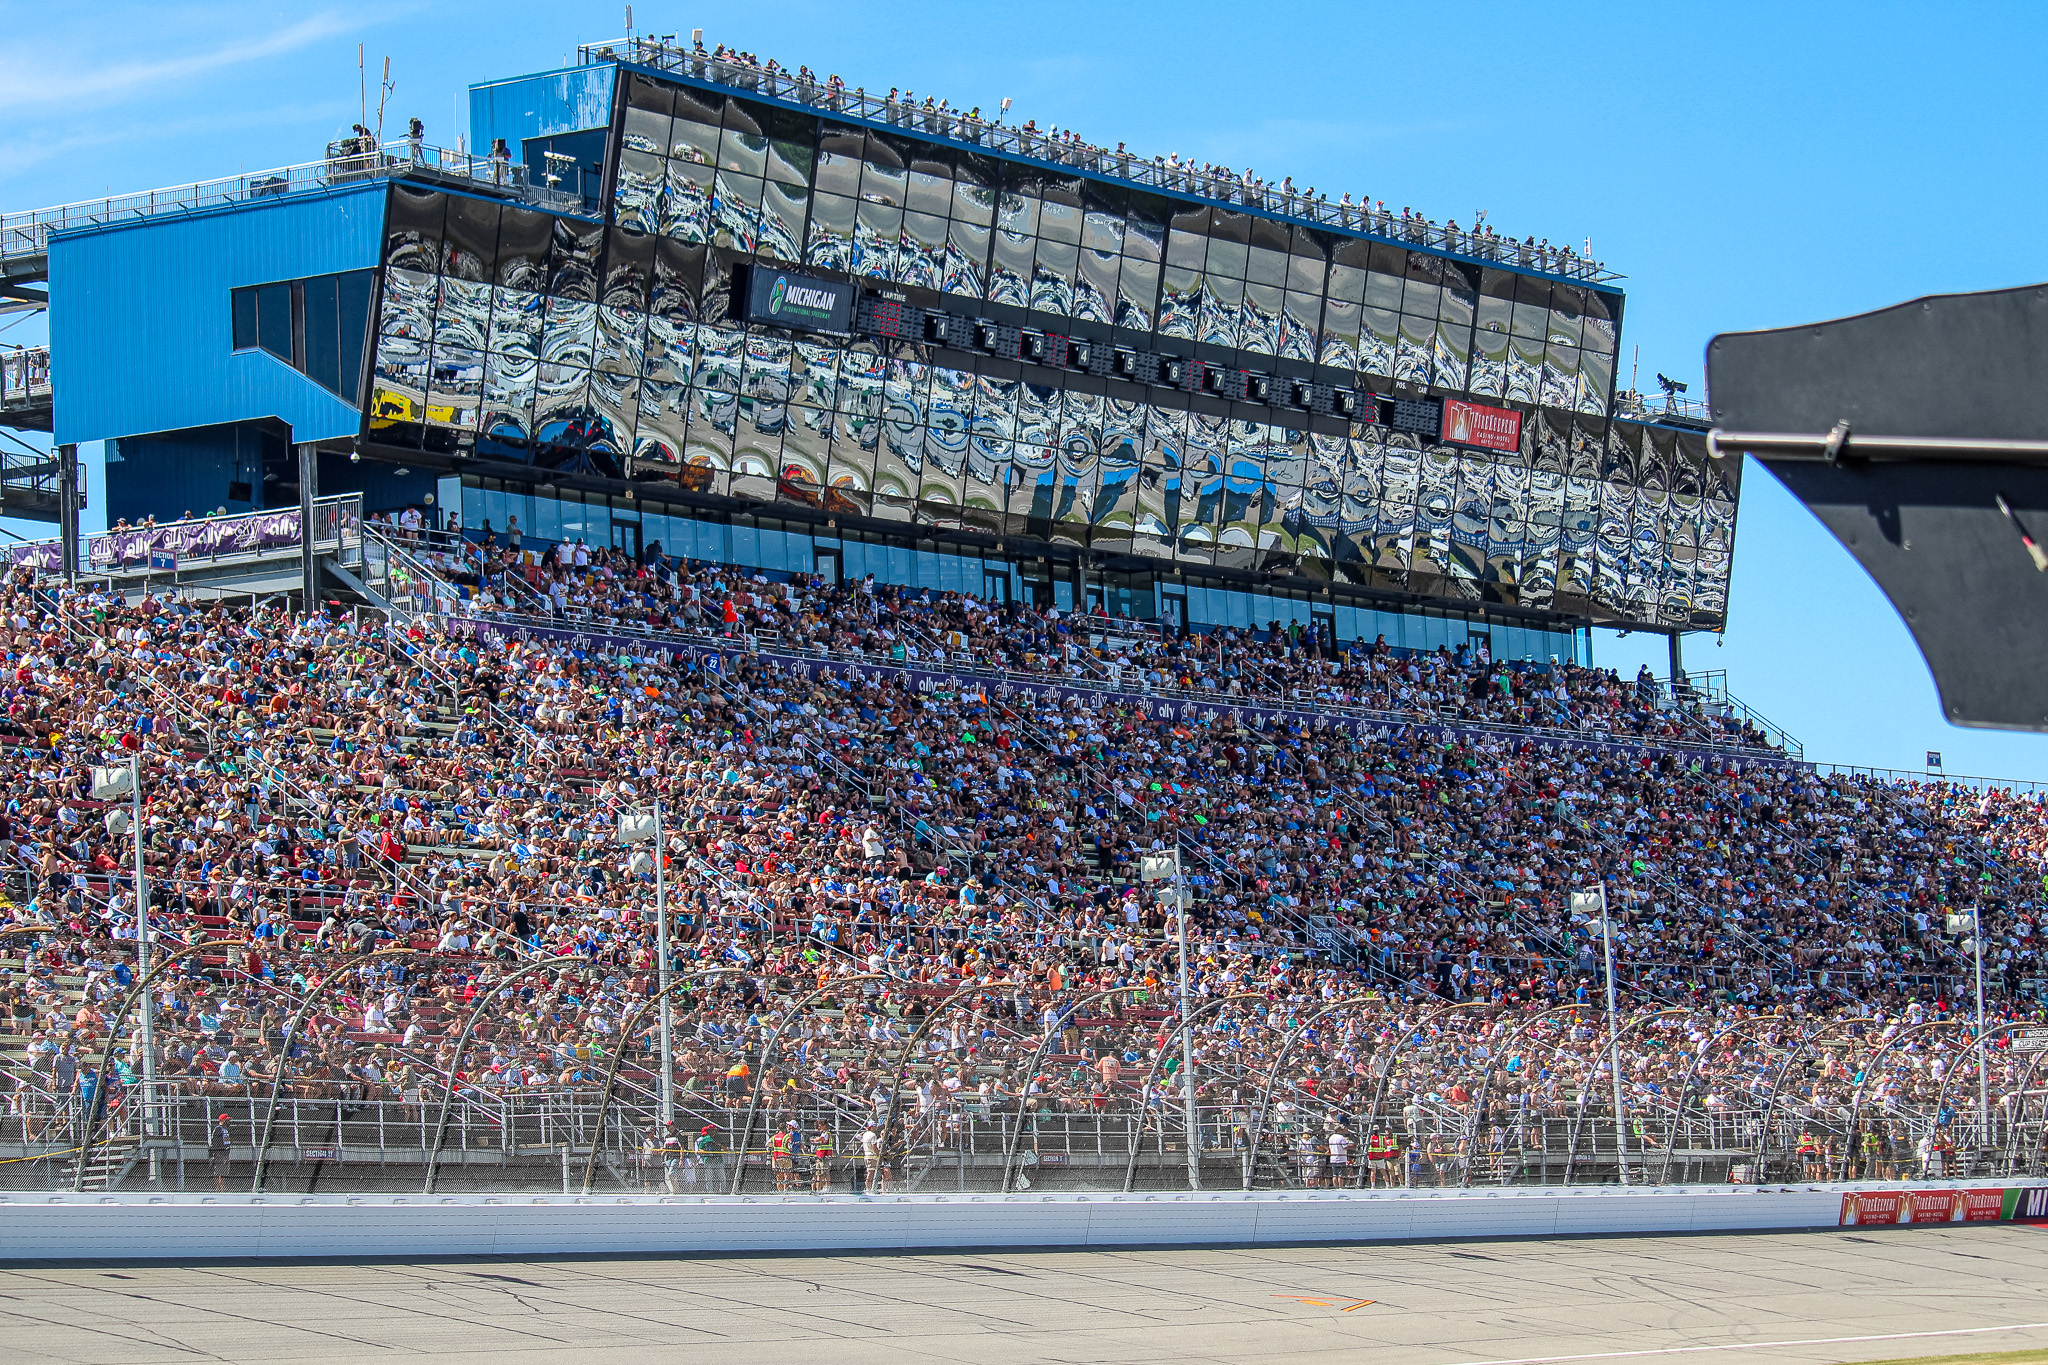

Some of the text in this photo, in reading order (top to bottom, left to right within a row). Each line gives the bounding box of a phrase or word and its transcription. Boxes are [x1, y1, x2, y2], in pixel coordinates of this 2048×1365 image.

[785, 285, 836, 311] MICHIGAN
[782, 306, 830, 319] INTERNATIONAL SPEEDWAY
[940, 322, 946, 336] 1
[988, 332, 994, 344] 2
[1035, 340, 1042, 353] 3
[1080, 350, 1087, 362] 4
[1128, 358, 1134, 370] 5
[1172, 366, 1178, 378] 6
[1216, 374, 1222, 386] 7
[1260, 382, 1266, 394] 8
[1396, 381, 1428, 394] POS. CAR
[1304, 390, 1310, 402] 9
[1344, 397, 1354, 410] 10
[24, 550, 49, 568] ally
[126, 536, 151, 556] ally
[197, 526, 222, 547] ally
[270, 516, 298, 538] ally
[152, 551, 174, 560] SECTION
[160, 559, 166, 568] 7
[710, 658, 718, 668] 22
[919, 677, 938, 696] ally
[1158, 704, 1175, 720] ally
[306, 1150, 327, 1158] SECTION
[2026, 1189, 2048, 1216] MI
